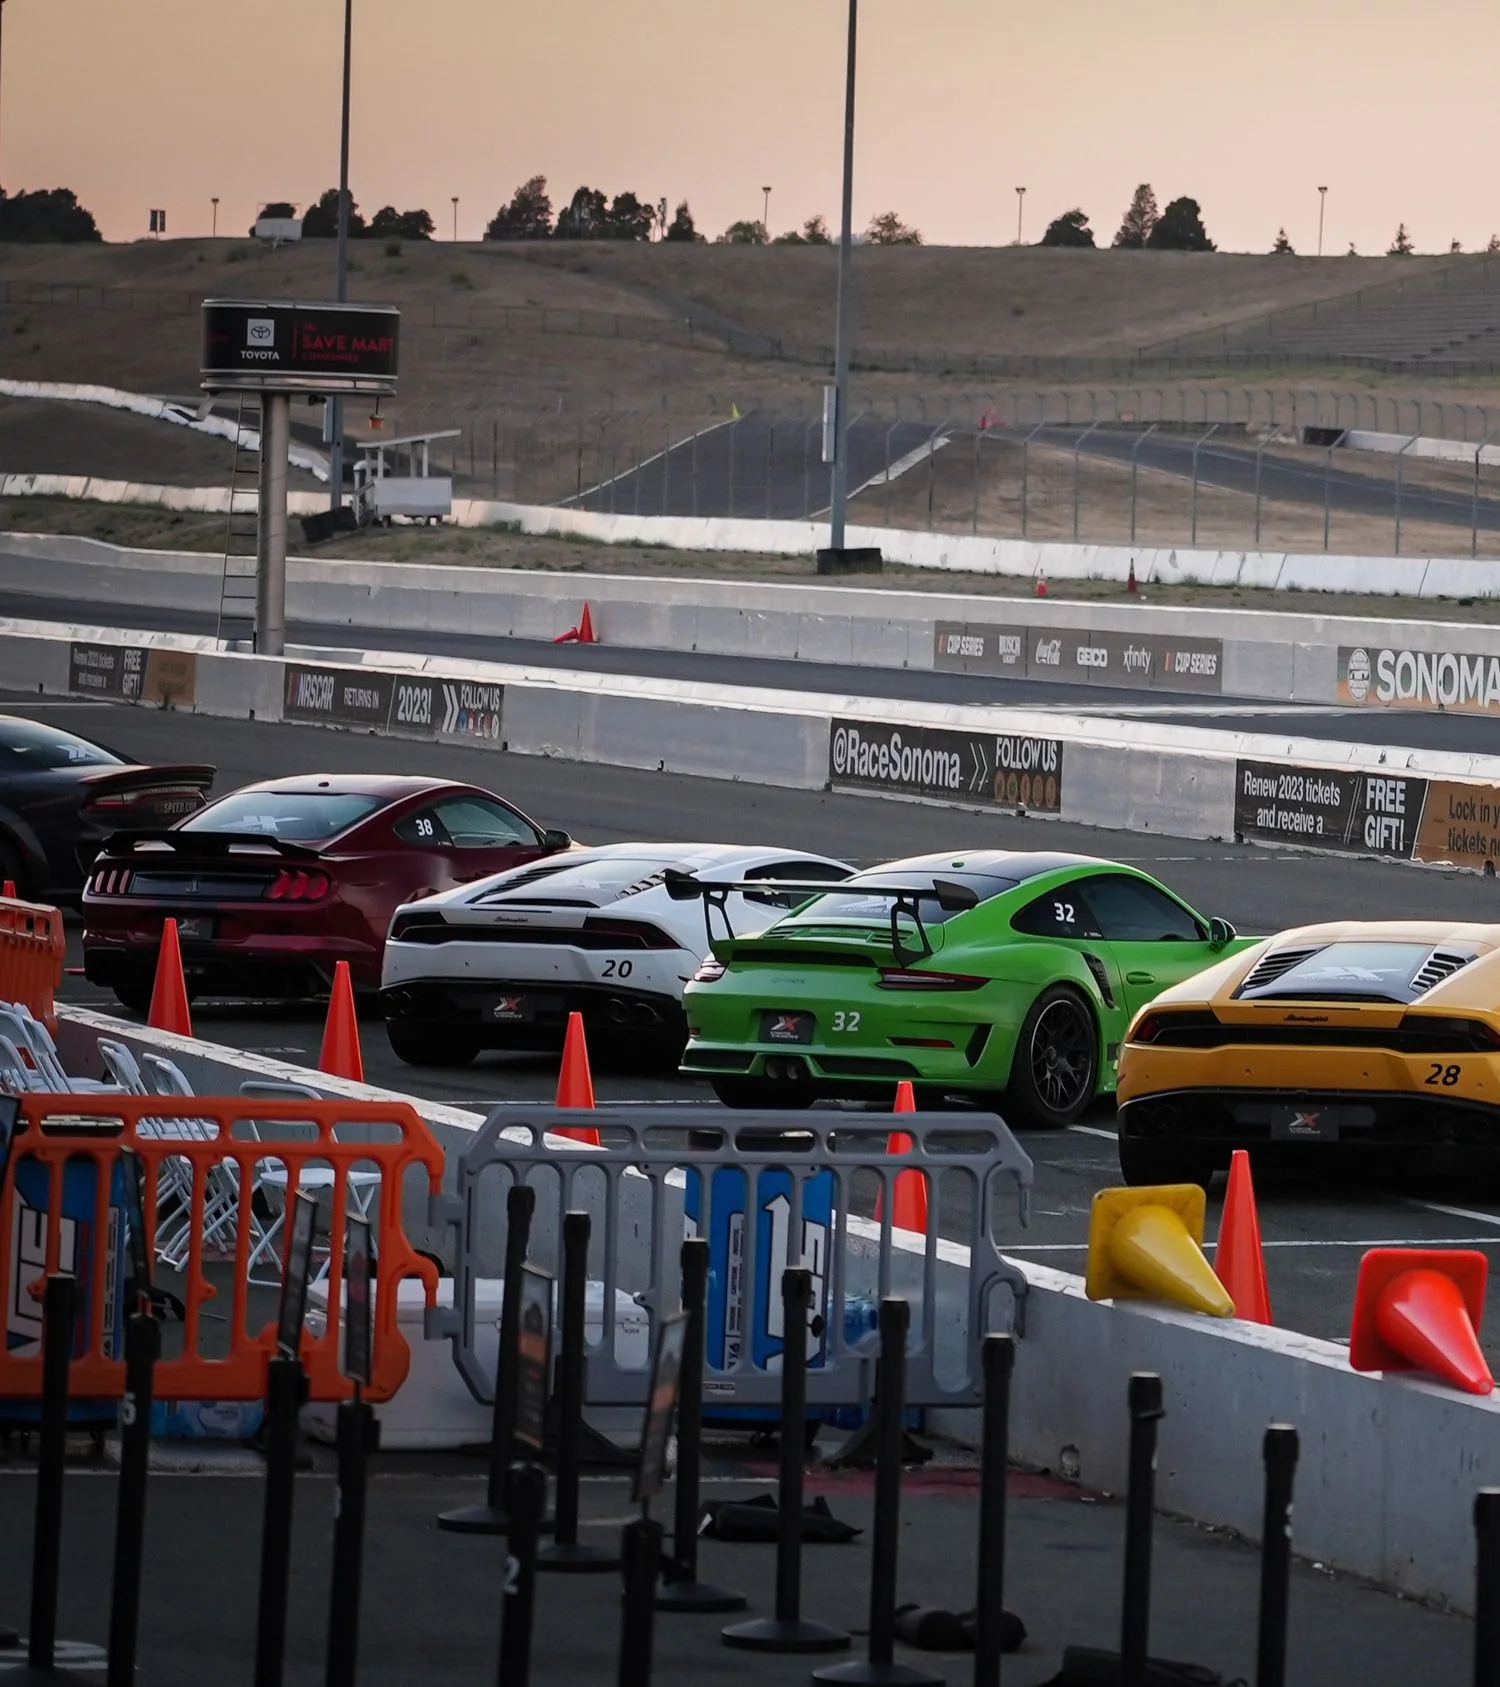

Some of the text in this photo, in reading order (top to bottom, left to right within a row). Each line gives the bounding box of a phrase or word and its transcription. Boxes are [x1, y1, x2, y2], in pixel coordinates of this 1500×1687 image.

[240, 350, 280, 360] TOYOTA
[302, 334, 394, 353] SAVE MART
[947, 634, 985, 657] CUP SERIES
[999, 635, 1021, 657] BUSCH
[1077, 647, 1108, 667] GEICO
[124, 649, 141, 671] FREE
[1123, 644, 1151, 673] xfinity
[1175, 652, 1217, 675] CUP SERIES
[122, 673, 141, 696] GIFT!
[297, 673, 380, 711] NASCAR RETURNS IN
[397, 685, 432, 724] 2023!
[460, 684, 500, 711] FOLLOW US
[833, 727, 961, 789] @RaceSonoma
[995, 737, 1058, 772] FOLLOW US
[1243, 770, 1341, 807] Renew 2023 tickets
[1366, 778, 1406, 814] FREE
[1256, 803, 1324, 835] and receive a
[1449, 793, 1476, 822] Lock
[1480, 800, 1490, 823] in
[415, 818, 433, 836] 38
[1364, 815, 1404, 852] GIFT!
[1448, 827, 1487, 854] tickets
[1054, 902, 1075, 923] 32
[602, 959, 633, 978] 20
[832, 1011, 860, 1031] 32
[1425, 1063, 1462, 1087] 28
[504, 1555, 520, 1595] 2
